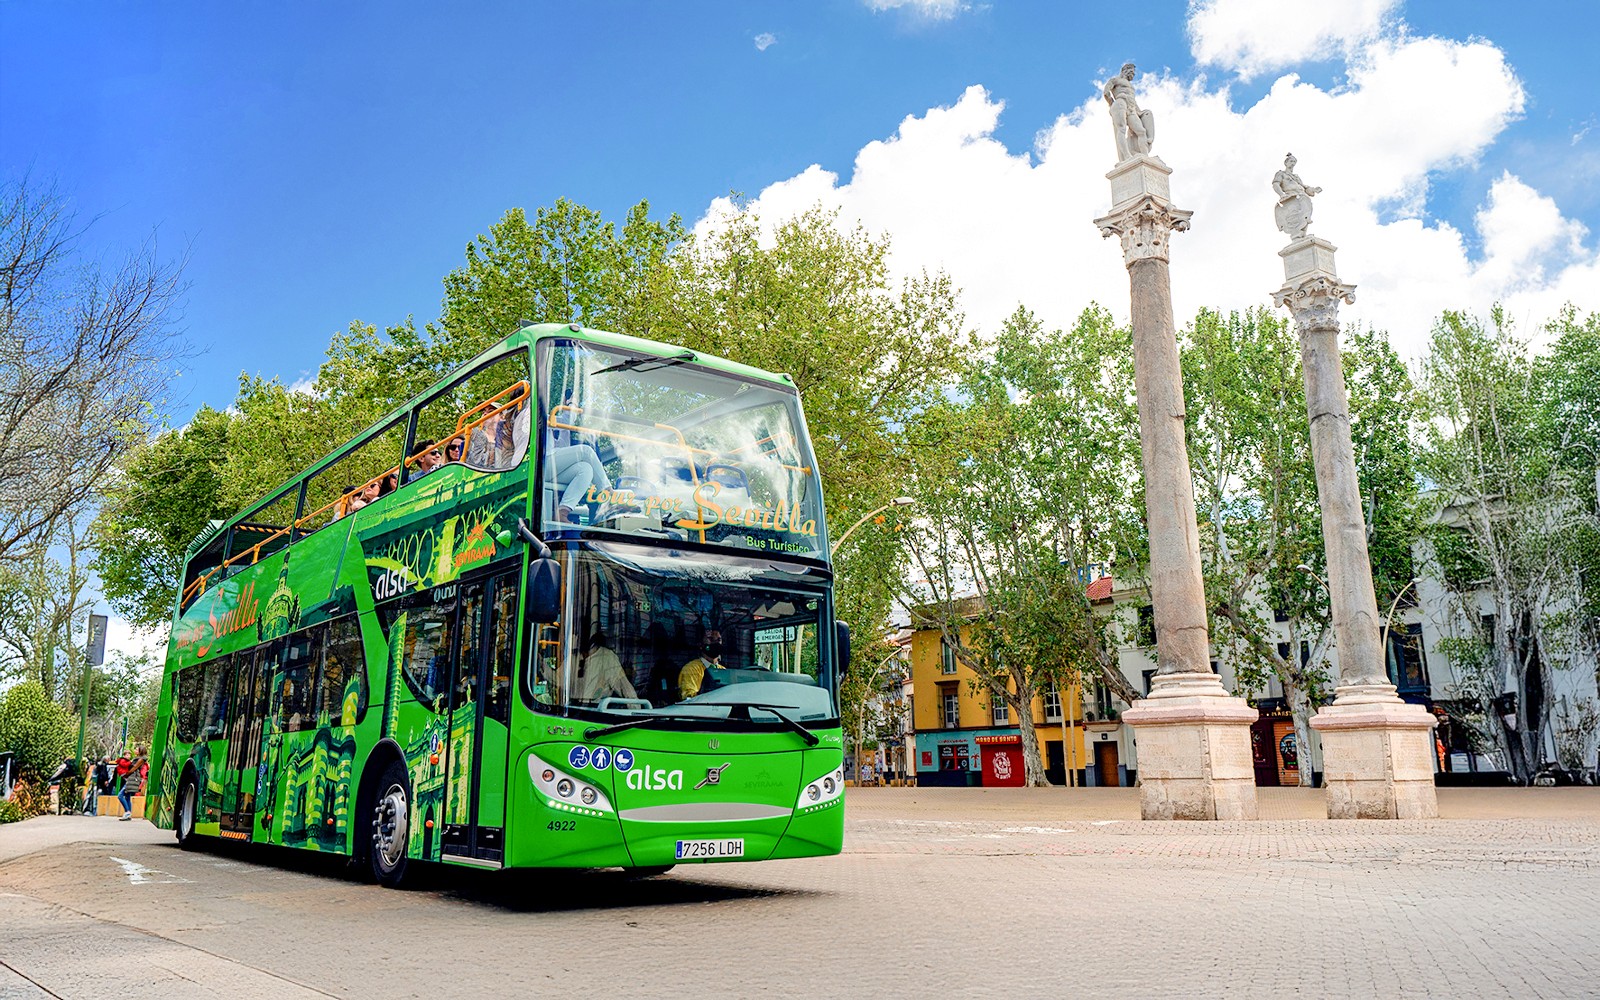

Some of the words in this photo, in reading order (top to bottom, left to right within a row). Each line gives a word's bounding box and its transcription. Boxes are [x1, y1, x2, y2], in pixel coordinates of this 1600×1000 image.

[586, 484, 637, 507] tour
[644, 495, 684, 516] por
[674, 481, 818, 536] Sevilla
[454, 541, 496, 568] SEVIRAMA
[746, 536, 766, 549] Bus
[767, 538, 810, 554] Turístico
[375, 565, 409, 600] alsa
[197, 579, 259, 658] Sevilla
[762, 633, 794, 641] EMERGENA
[626, 764, 683, 790] alsa
[547, 821, 576, 831] 4922
[683, 842, 716, 857] 7256
[719, 841, 742, 855] LDH
